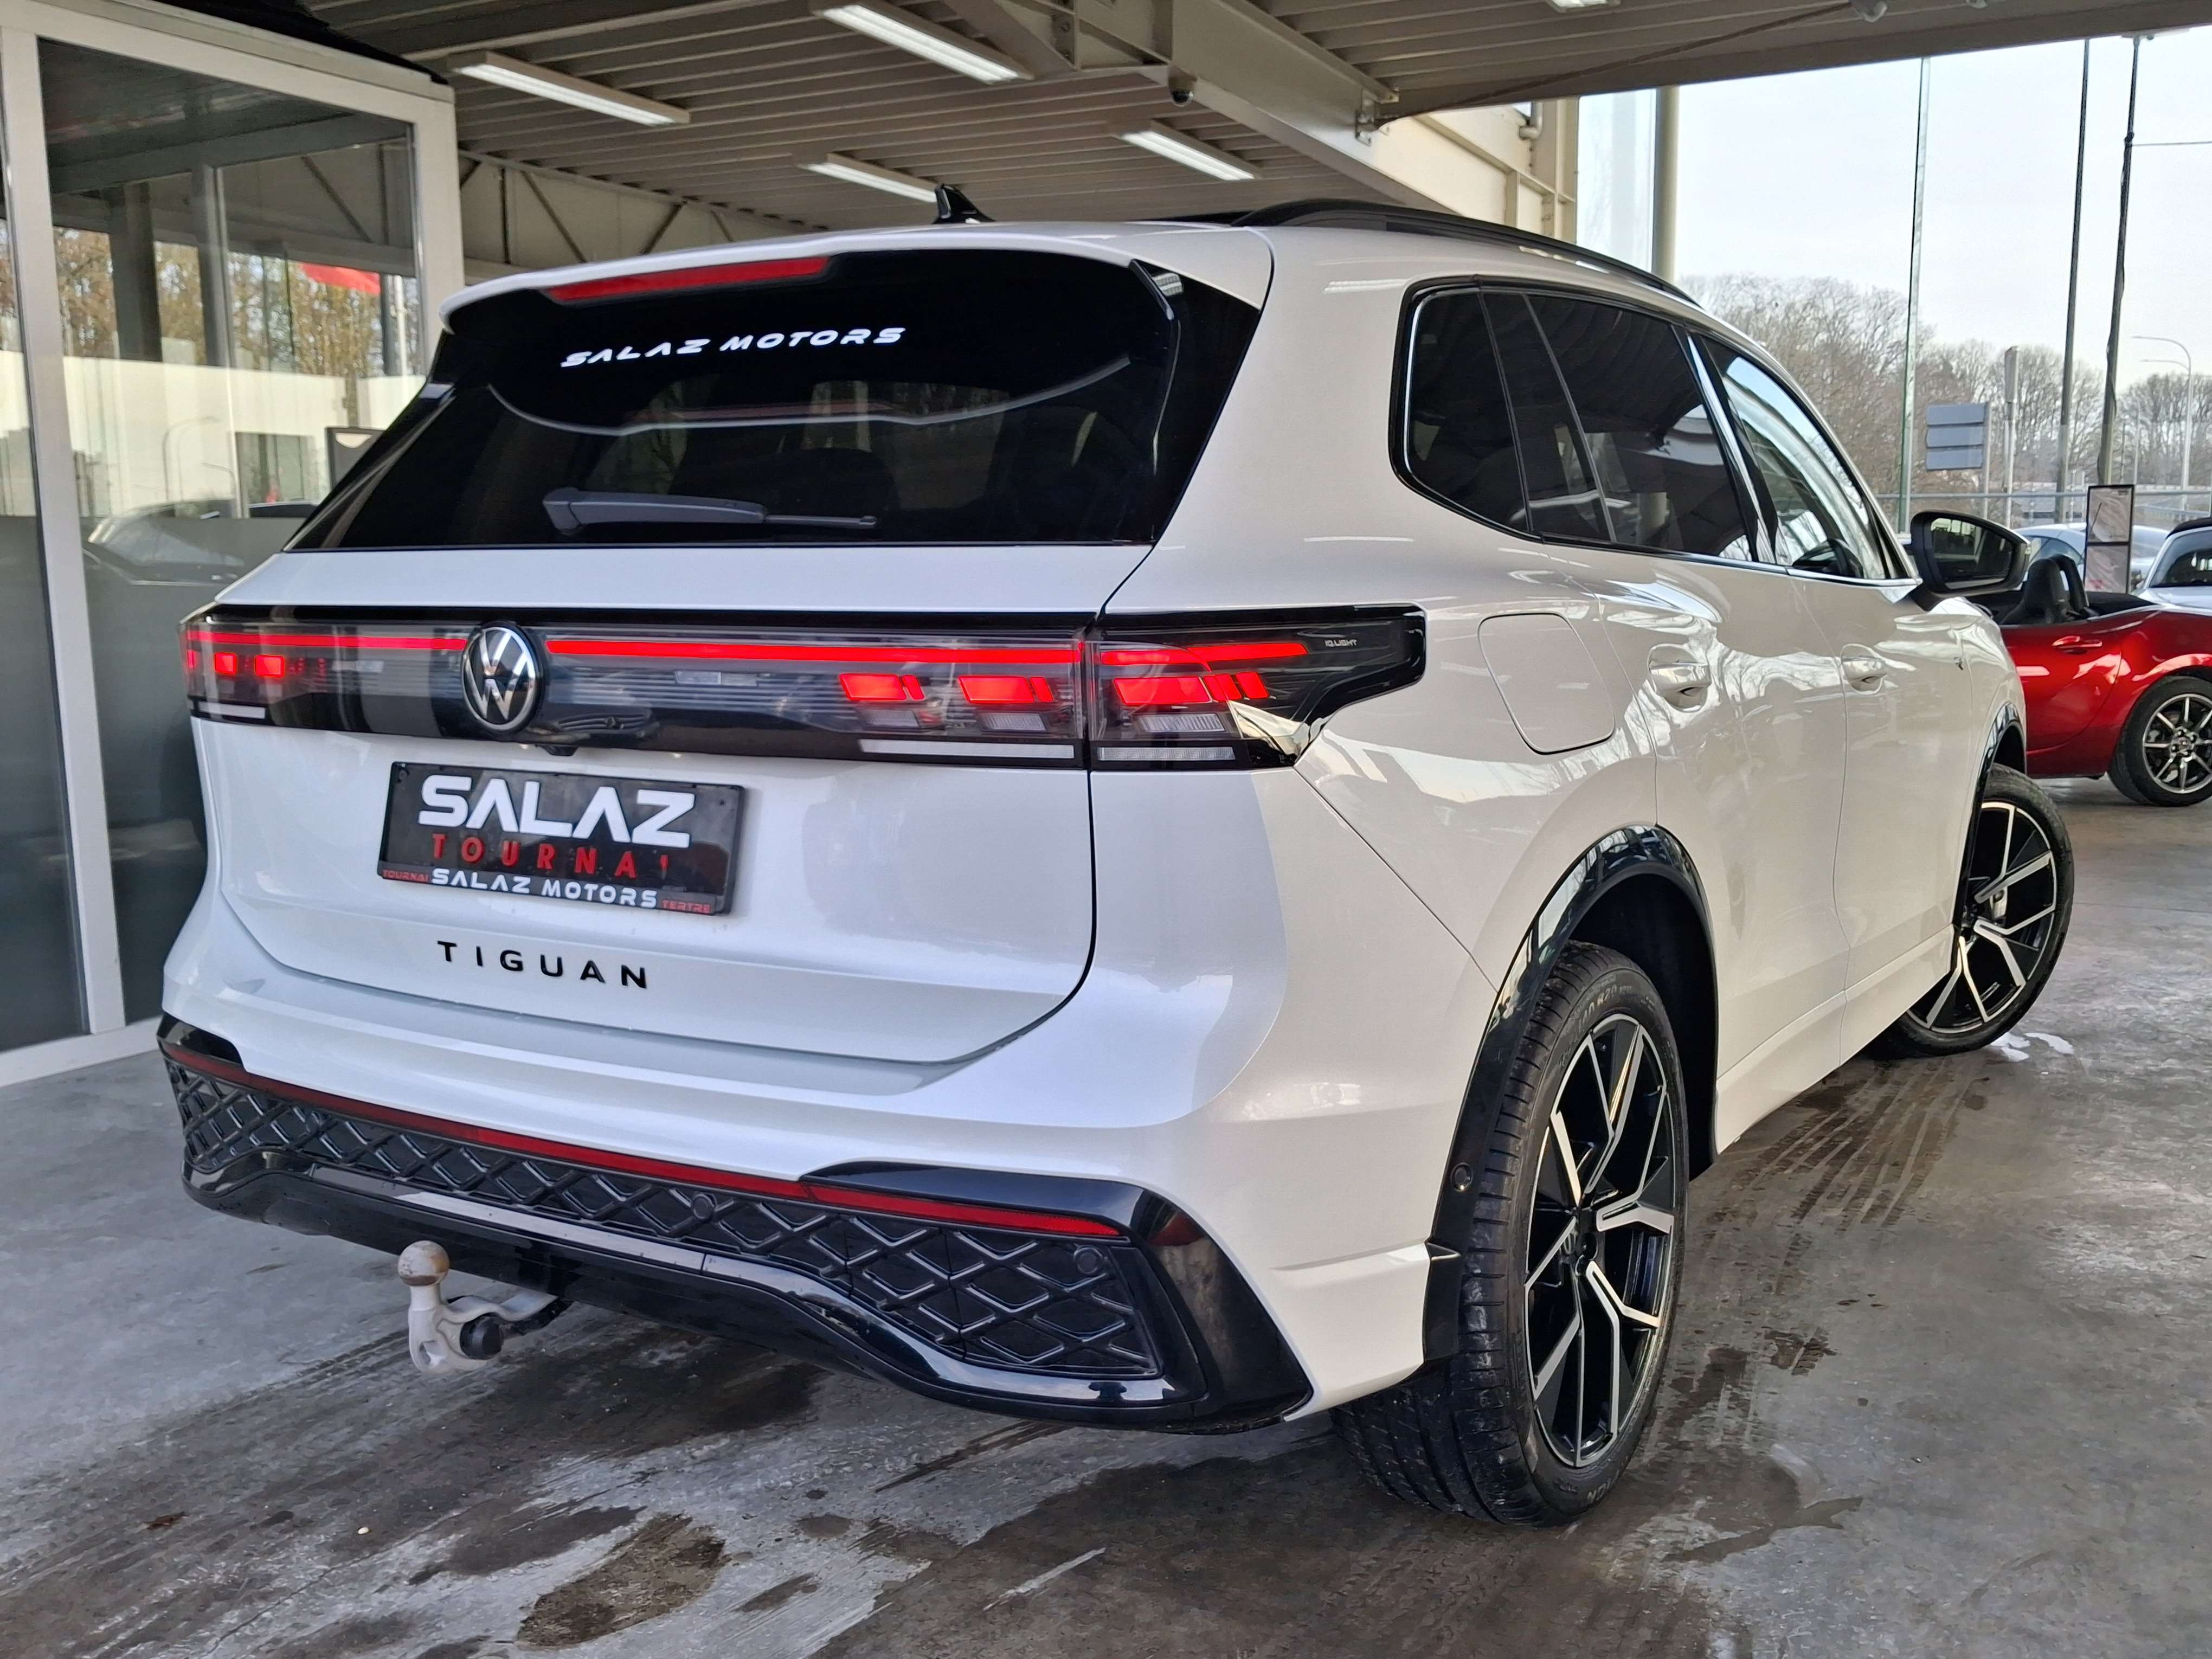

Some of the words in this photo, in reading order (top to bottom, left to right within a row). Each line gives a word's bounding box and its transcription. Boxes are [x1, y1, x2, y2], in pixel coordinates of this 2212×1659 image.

[561, 338, 711, 368] SALAZ
[719, 327, 906, 351] MOTORS
[418, 774, 696, 848] SALAZ
[382, 870, 429, 883] TOURNAI
[432, 868, 532, 894] SALAZ
[541, 878, 658, 909] MOTORS
[437, 941, 647, 989] TIGUAN
